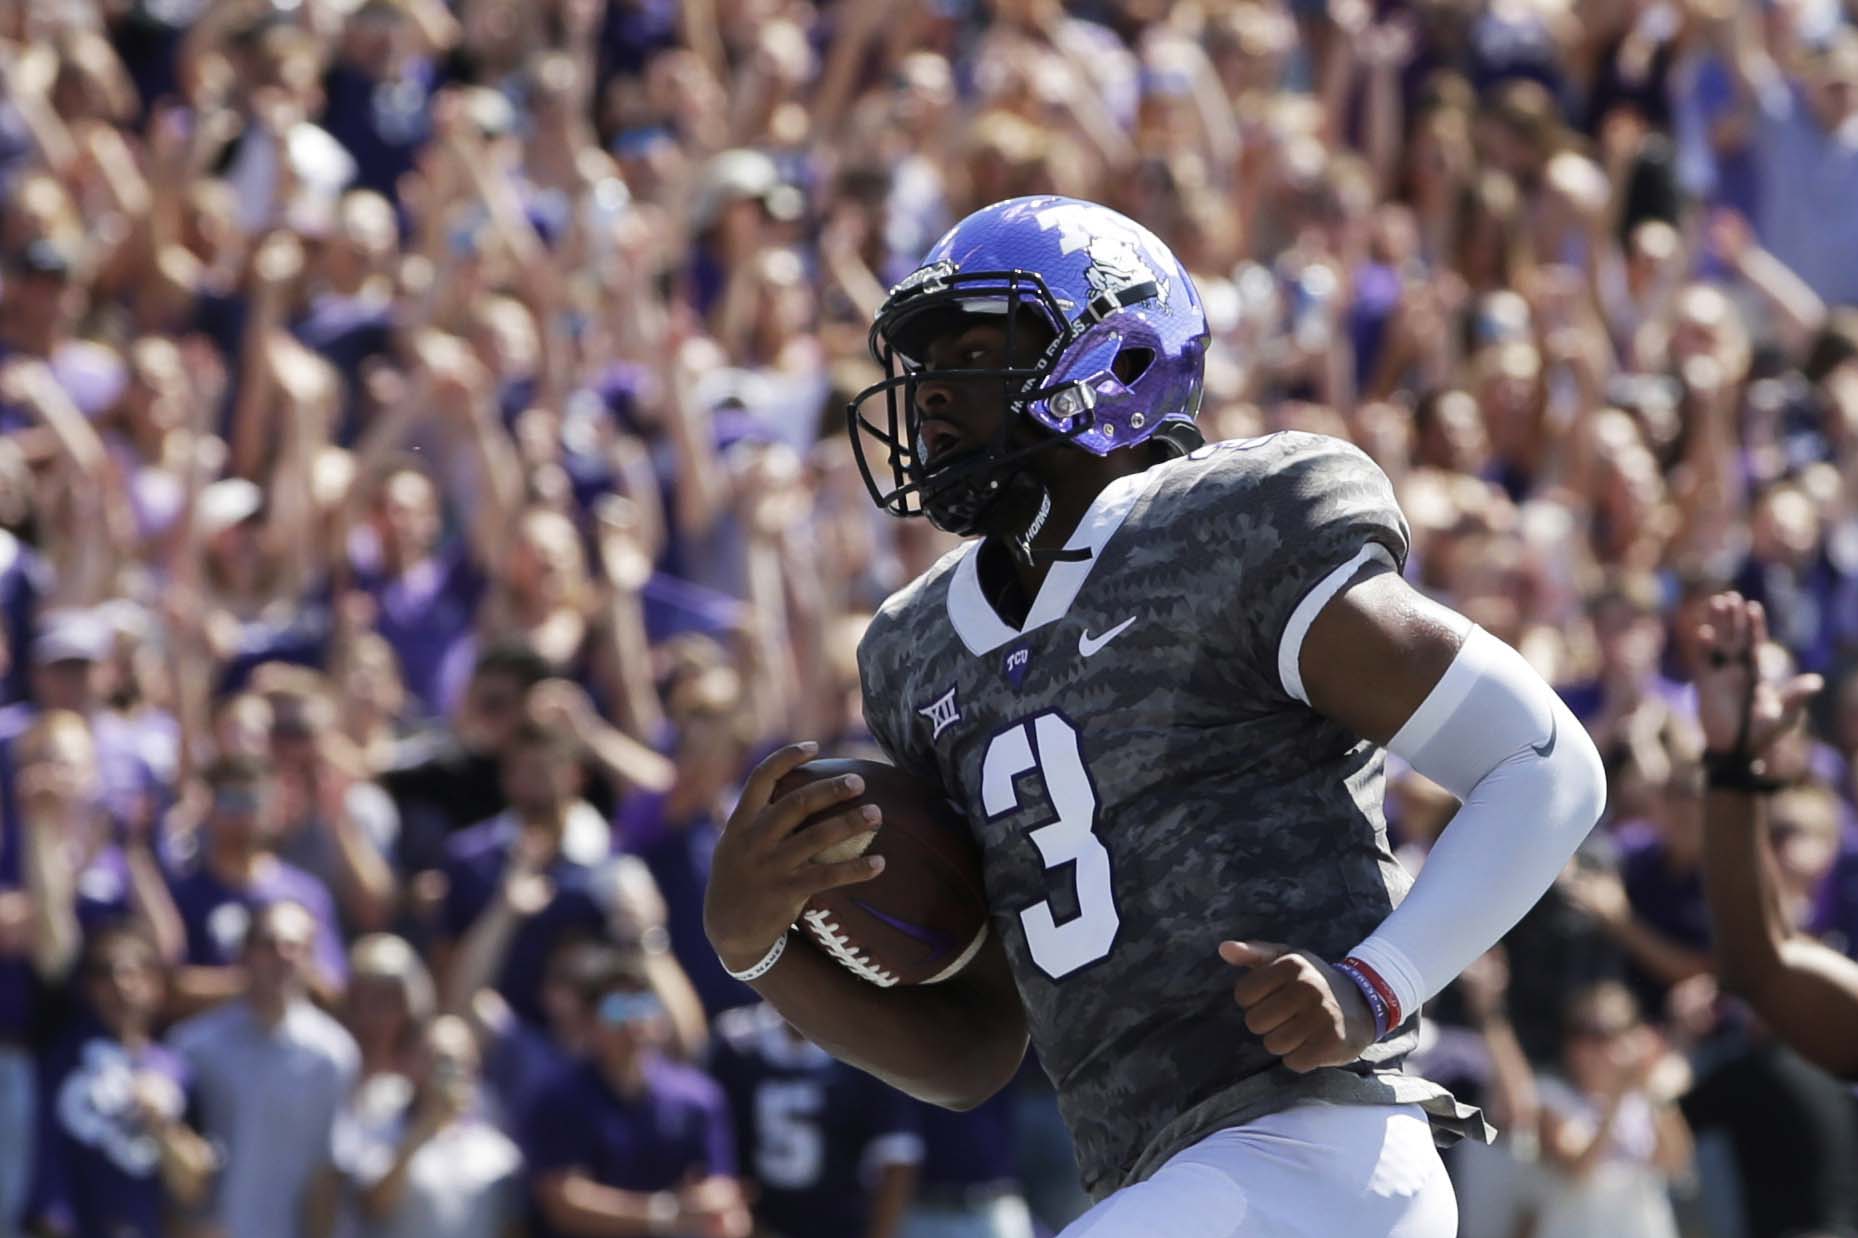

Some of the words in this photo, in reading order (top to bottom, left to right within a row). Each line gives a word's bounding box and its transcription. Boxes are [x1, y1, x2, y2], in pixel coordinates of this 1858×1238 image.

[1006, 648, 1029, 672] TCU
[918, 687, 960, 740] XII
[980, 710, 1121, 980] 3
[753, 1078, 826, 1190] 5
